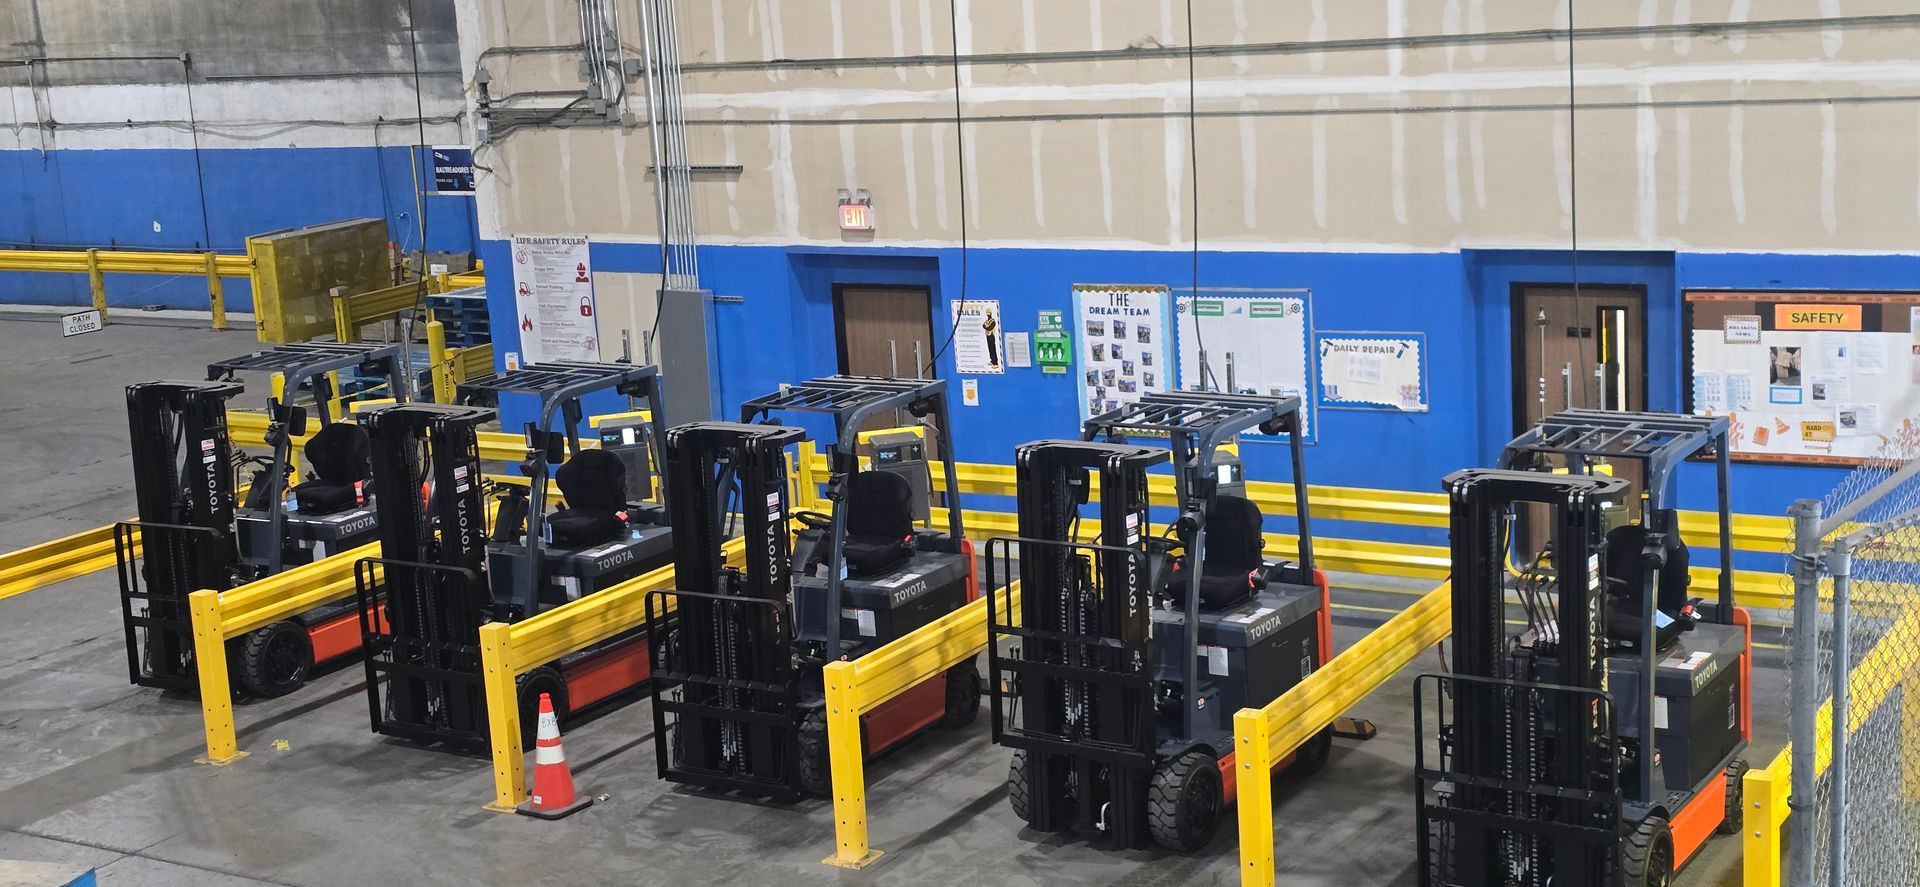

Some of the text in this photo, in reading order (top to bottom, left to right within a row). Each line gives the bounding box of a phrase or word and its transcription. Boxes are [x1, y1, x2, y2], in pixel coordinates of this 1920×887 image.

[844, 206, 866, 227] EXIT
[516, 237, 586, 246] LIFE SAFETY RULES
[1108, 293, 1130, 307] THE
[72, 314, 90, 323] PATH
[1089, 306, 1151, 316] DREAM TEAM
[1791, 312, 1844, 324] SAFETY
[69, 322, 96, 333] CLOSED
[1333, 344, 1396, 354] DAILY REPAIR
[206, 462, 219, 515] TOYOTA
[339, 516, 376, 535] TOYOTA
[457, 498, 471, 555] TOYOTA
[597, 550, 634, 571] TOYOTA
[767, 524, 778, 585] TOYOTA
[894, 580, 928, 603] TOYOTA
[1128, 553, 1137, 618] TOYOTA
[1250, 615, 1282, 640] TOYOTA
[1694, 660, 1718, 689] TOYOTA
